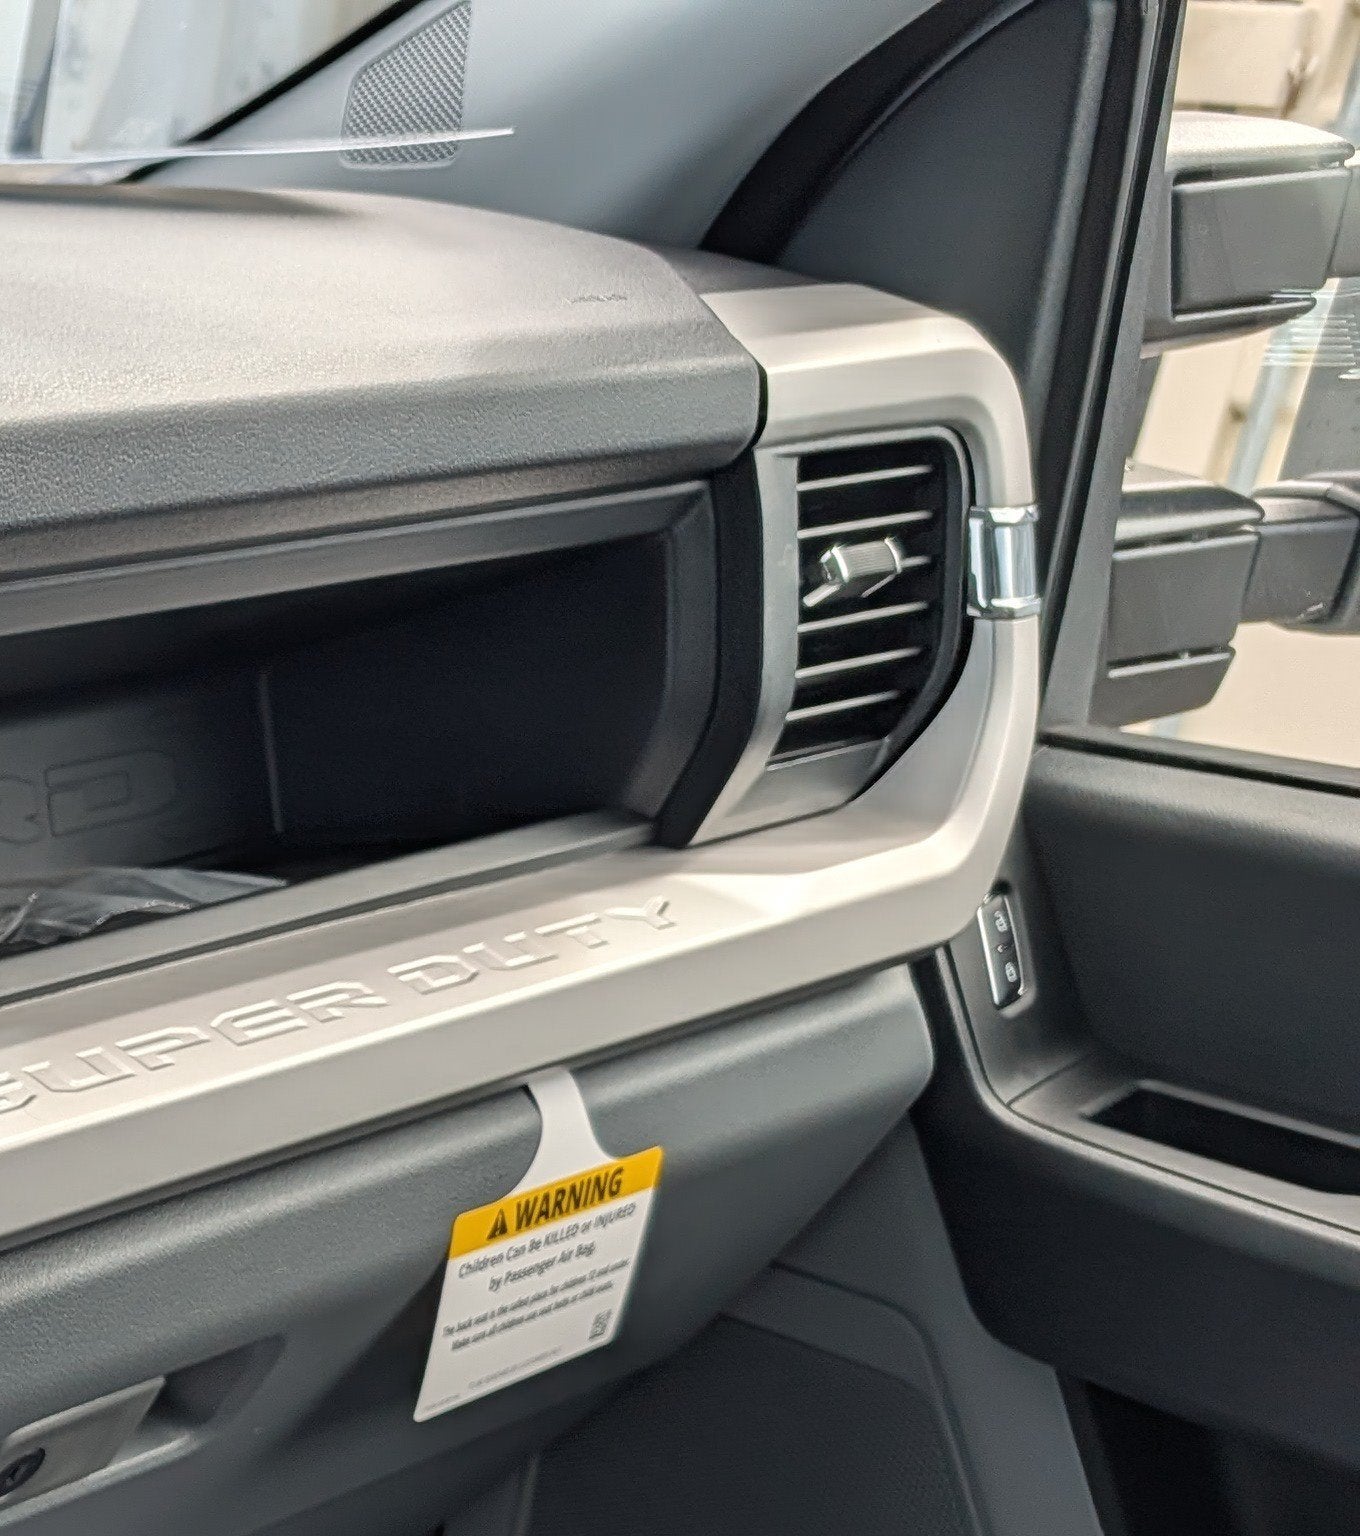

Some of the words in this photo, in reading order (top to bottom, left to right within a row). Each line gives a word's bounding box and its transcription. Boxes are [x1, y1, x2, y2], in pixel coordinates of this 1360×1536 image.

[388, 896, 678, 997] DUTY
[515, 1166, 624, 1232] WARNING
[458, 1251, 504, 1278] Children
[506, 1243, 526, 1262] Can
[543, 1222, 580, 1248] KILLED
[593, 1202, 637, 1229] INJURED
[488, 1275, 504, 1292] by
[503, 1255, 557, 1286] Passenger
